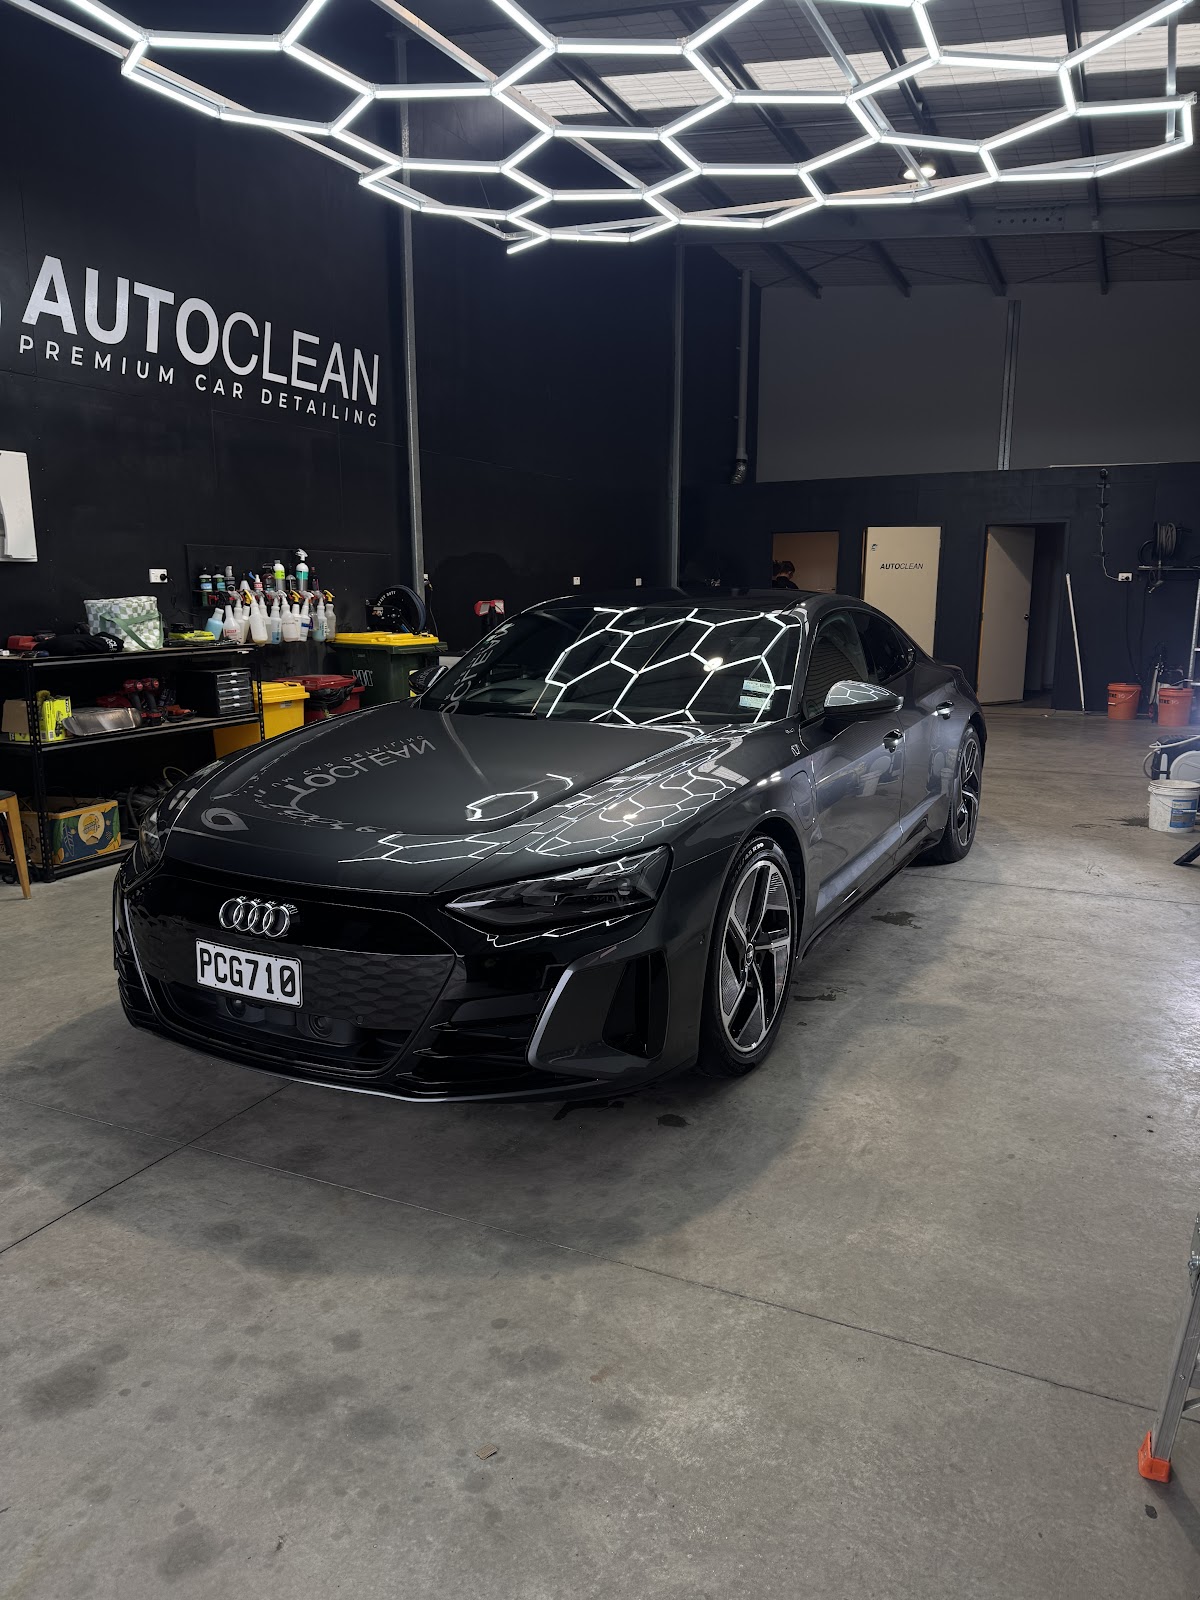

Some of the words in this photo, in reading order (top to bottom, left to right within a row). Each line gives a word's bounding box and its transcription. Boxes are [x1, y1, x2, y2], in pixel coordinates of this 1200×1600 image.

[21, 254, 380, 406] AUTOCLEAN
[19, 333, 175, 386] PREMIUM
[194, 374, 244, 400] CAR
[261, 388, 377, 428] DETAILING
[879, 562, 924, 570] AUTOCLEAN
[199, 947, 297, 998] PCG710
